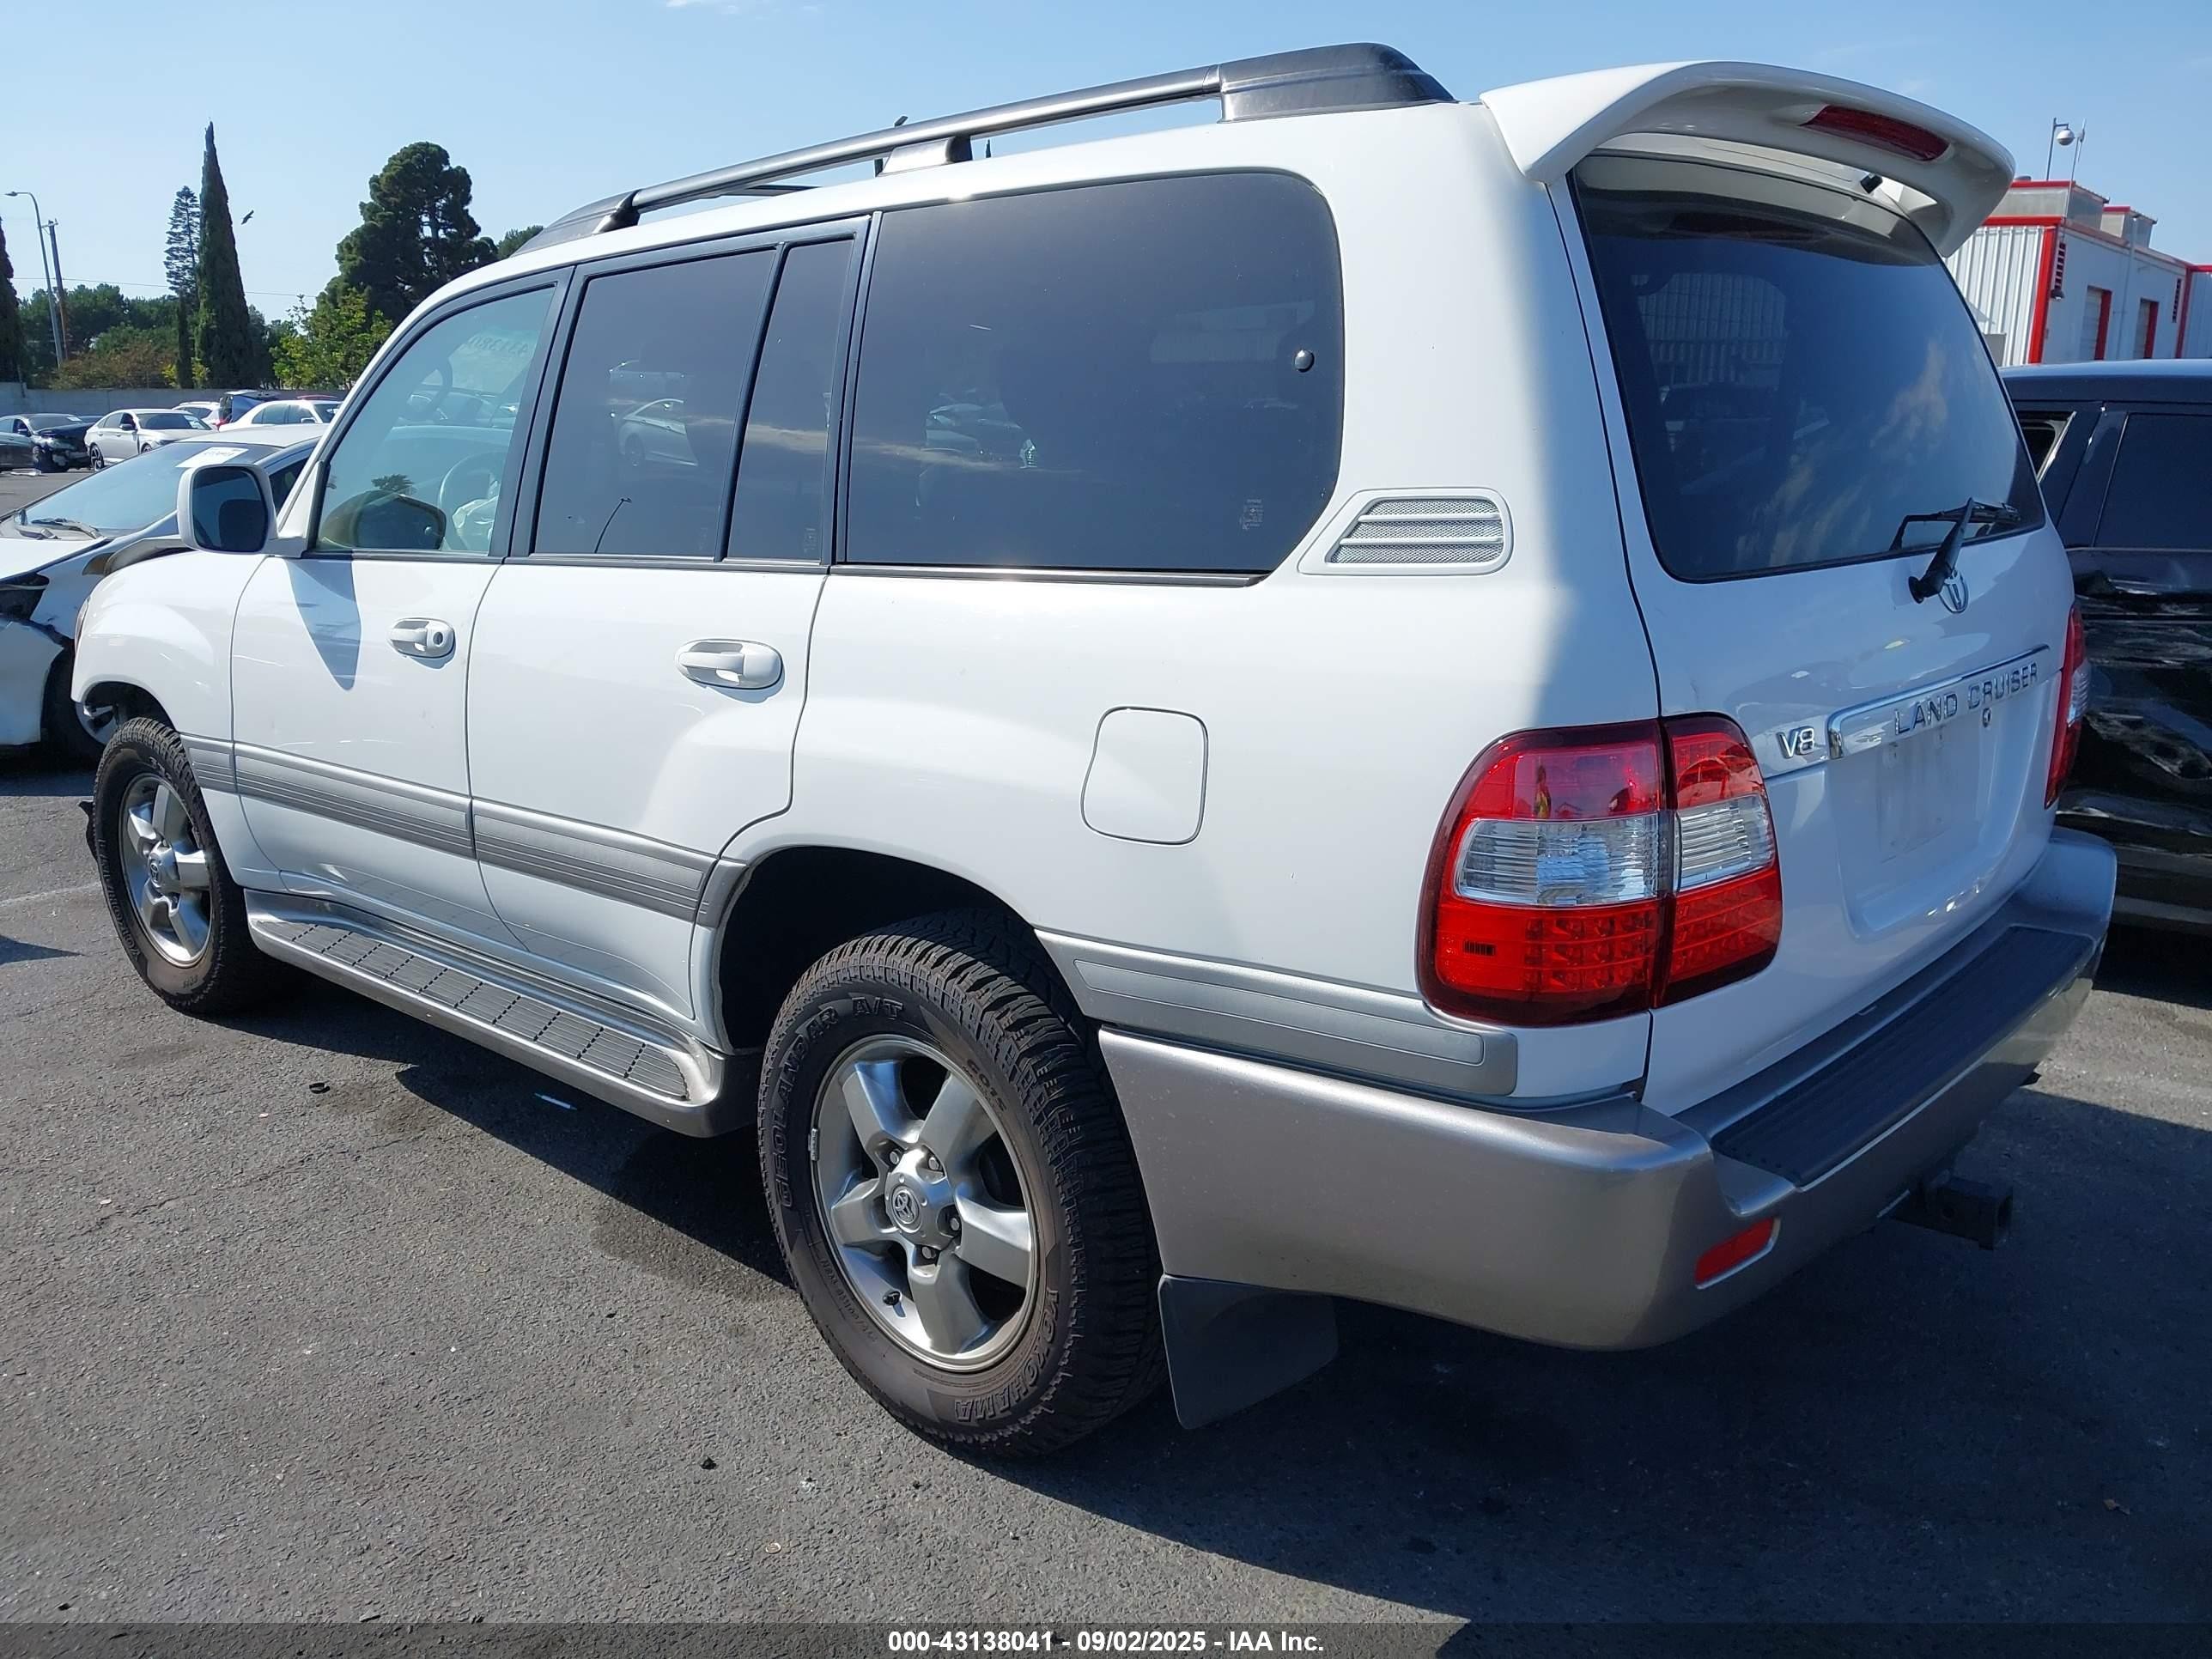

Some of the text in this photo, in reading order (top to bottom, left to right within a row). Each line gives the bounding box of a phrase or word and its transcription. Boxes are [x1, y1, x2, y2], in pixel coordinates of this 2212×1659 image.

[1776, 726, 1815, 759] V8
[1894, 662, 2039, 736] LAND CRUISER
[771, 996, 903, 1207] GEOLANDAR A/T
[955, 1287, 1059, 1422] YOKOHAMA
